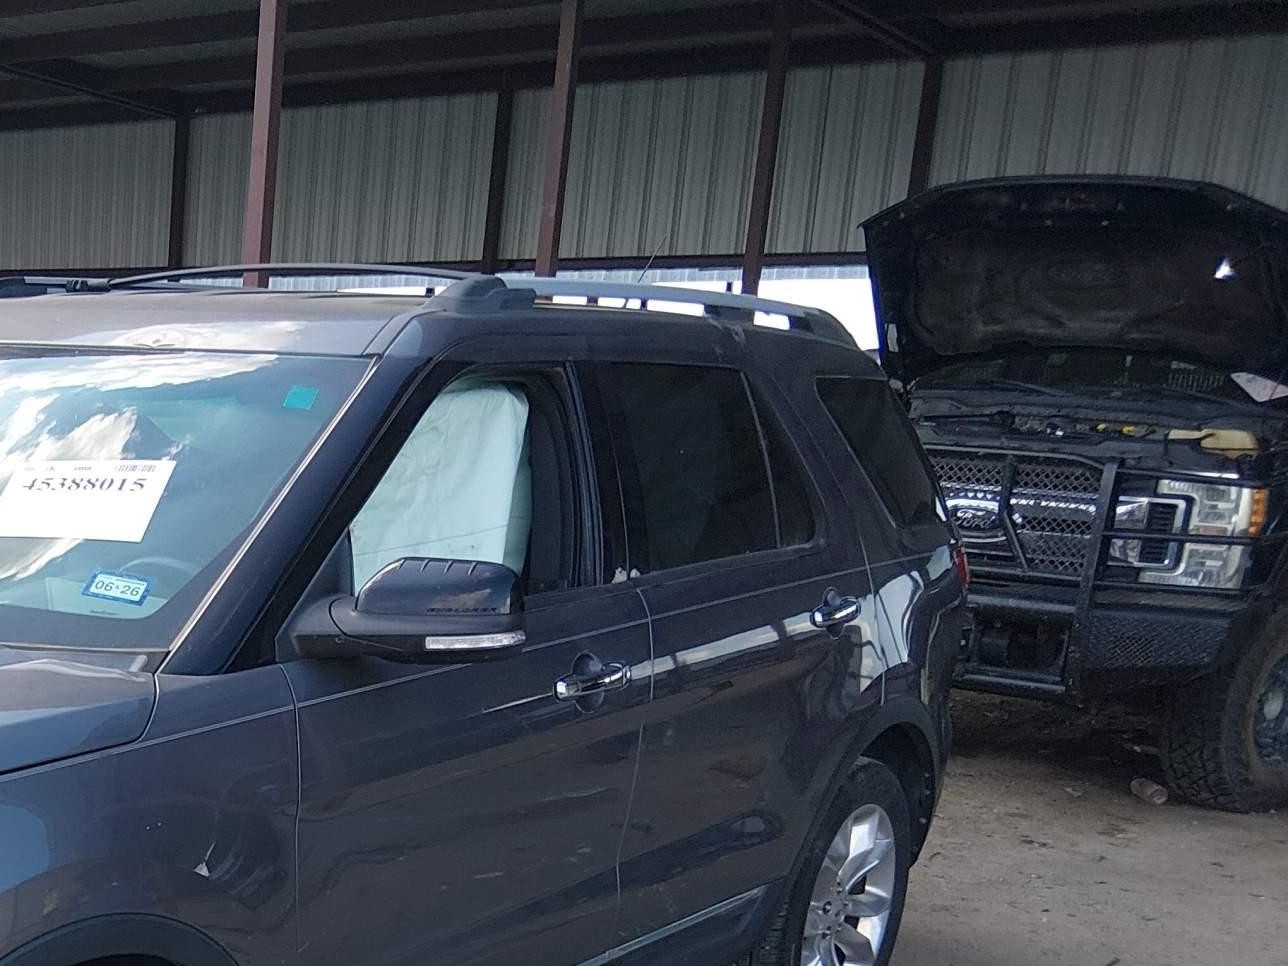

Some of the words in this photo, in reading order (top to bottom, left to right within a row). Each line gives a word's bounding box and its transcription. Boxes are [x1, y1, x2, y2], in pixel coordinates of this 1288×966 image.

[23, 478, 147, 491] 45388015
[955, 509, 995, 528] Ford
[94, 580, 115, 592] 06
[119, 585, 142, 597] 26
